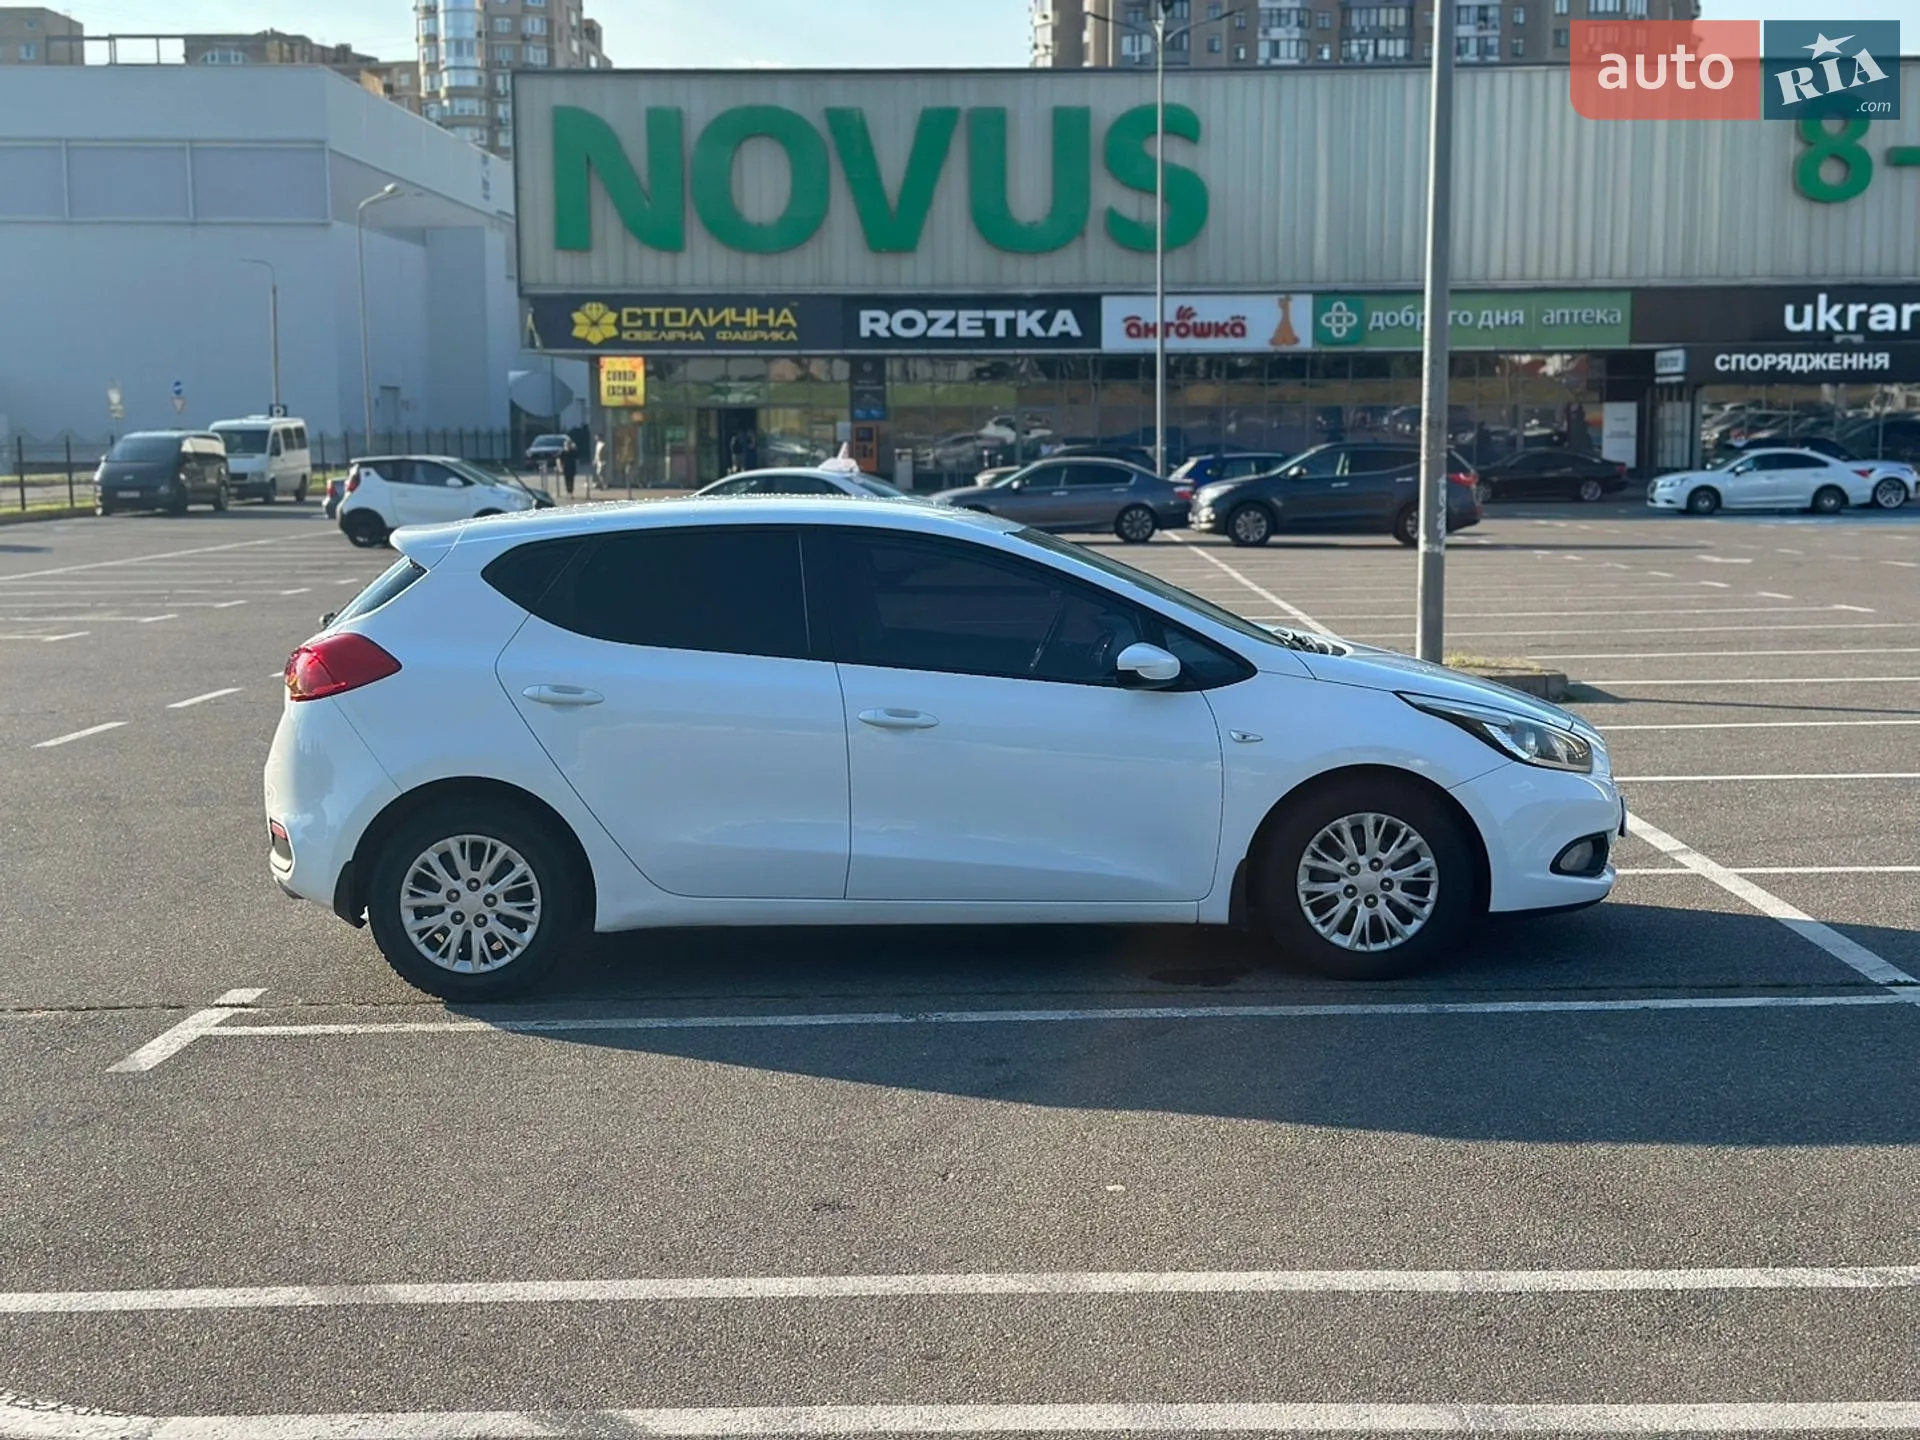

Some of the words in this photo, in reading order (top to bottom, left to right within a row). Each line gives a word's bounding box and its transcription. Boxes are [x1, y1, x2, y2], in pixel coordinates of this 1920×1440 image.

[551, 102, 1209, 255] NOVUS
[621, 307, 798, 328] СТОЛИЧНА
[859, 308, 1083, 338] ROZETKA
[1367, 304, 1474, 332] добрго
[1477, 307, 1525, 331] дня
[1541, 306, 1622, 326] аптека
[621, 329, 705, 342] ЮВЕЛІРНА
[715, 329, 798, 342] ФАБРИКА
[1714, 352, 1890, 374] СПОРЯДЖЕННЯ
